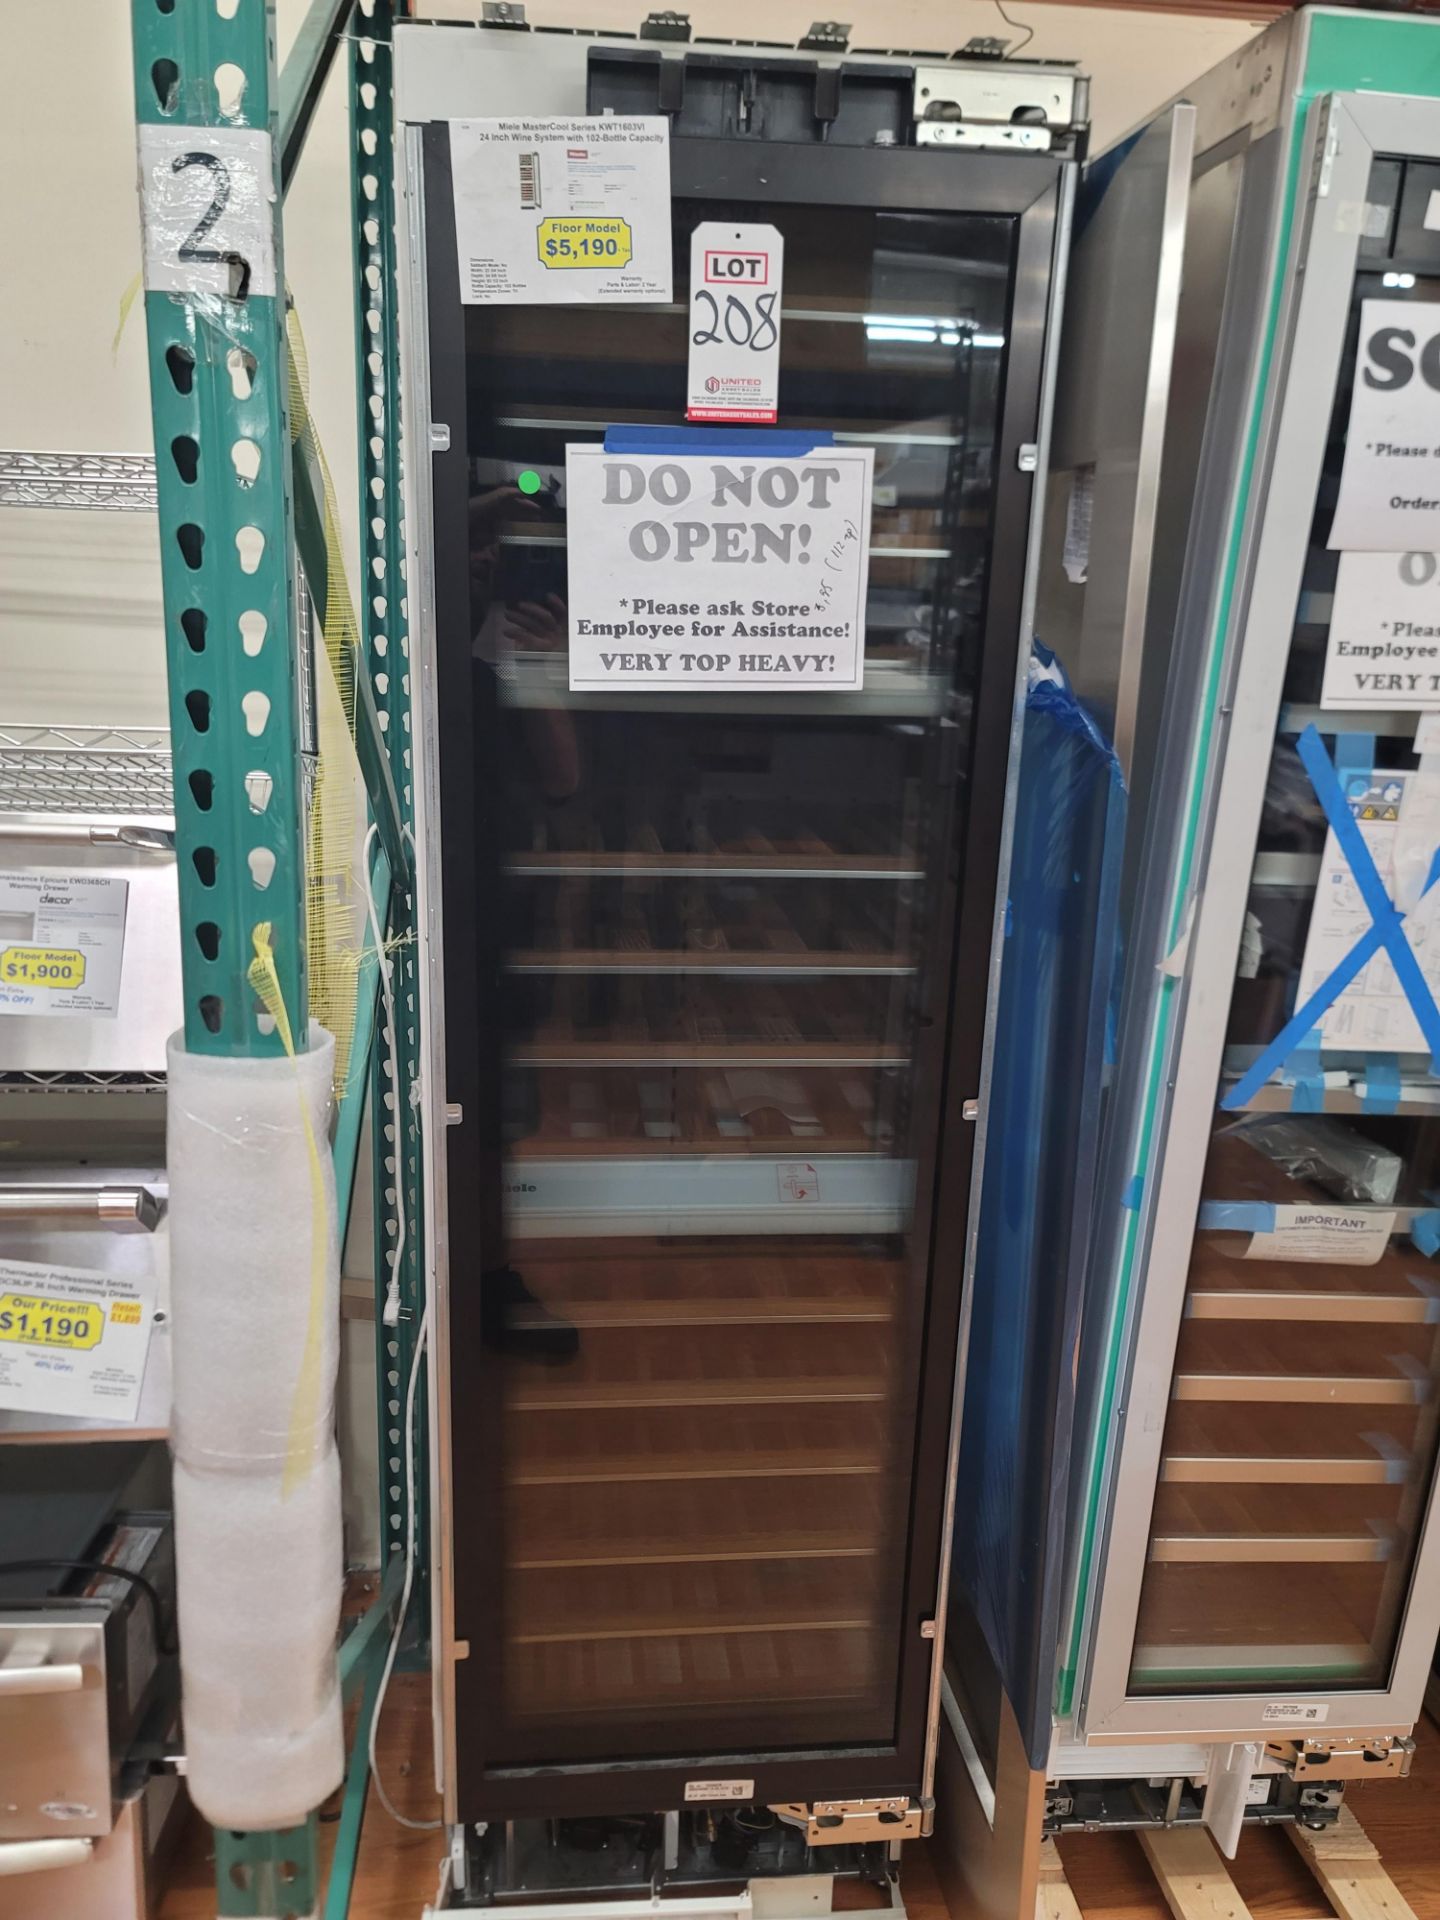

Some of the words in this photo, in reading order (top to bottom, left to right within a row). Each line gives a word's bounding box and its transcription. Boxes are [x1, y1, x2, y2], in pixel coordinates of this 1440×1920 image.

[498, 123, 520, 131] Miele
[522, 123, 569, 131] MasterCool
[571, 123, 596, 131] Series
[479, 134, 490, 142] 24
[491, 134, 510, 142] Inch
[512, 134, 533, 142] Wine
[534, 134, 564, 143] System
[567, 134, 584, 142] with
[586, 134, 627, 142] 102-Bottle
[628, 135, 664, 144] Capacity
[172, 152, 241, 263] 2
[552, 223, 582, 233] Floor
[585, 223, 621, 233] Model
[546, 238, 618, 259] $5,190
[712, 257, 761, 277] LOT
[692, 289, 778, 351] 208
[721, 378, 762, 386] UNITED
[601, 463, 691, 506] DO
[710, 464, 840, 509] NOT
[1390, 496, 1440, 510] Order
[629, 520, 812, 564] OPEN!
[706, 599, 745, 616] ask
[752, 600, 811, 616] Store
[577, 620, 685, 639] Employee
[691, 621, 726, 637] for
[732, 622, 850, 638] Assistance!
[1336, 641, 1439, 660] Employee
[599, 653, 672, 671] VERY
[680, 654, 731, 672] TOP
[739, 655, 835, 672] HEAVY!
[1354, 673, 1421, 691] VERY
[39, 892, 74, 905] dacor
[14, 952, 42, 960] Floor
[45, 953, 77, 962] Model
[6, 963, 73, 980] $1,900
[1295, 1215, 1367, 1229] IMPORTANT
[106, 1278, 134, 1289] Series
[12, 1297, 36, 1310] Our
[0, 1311, 89, 1338] $1,190
